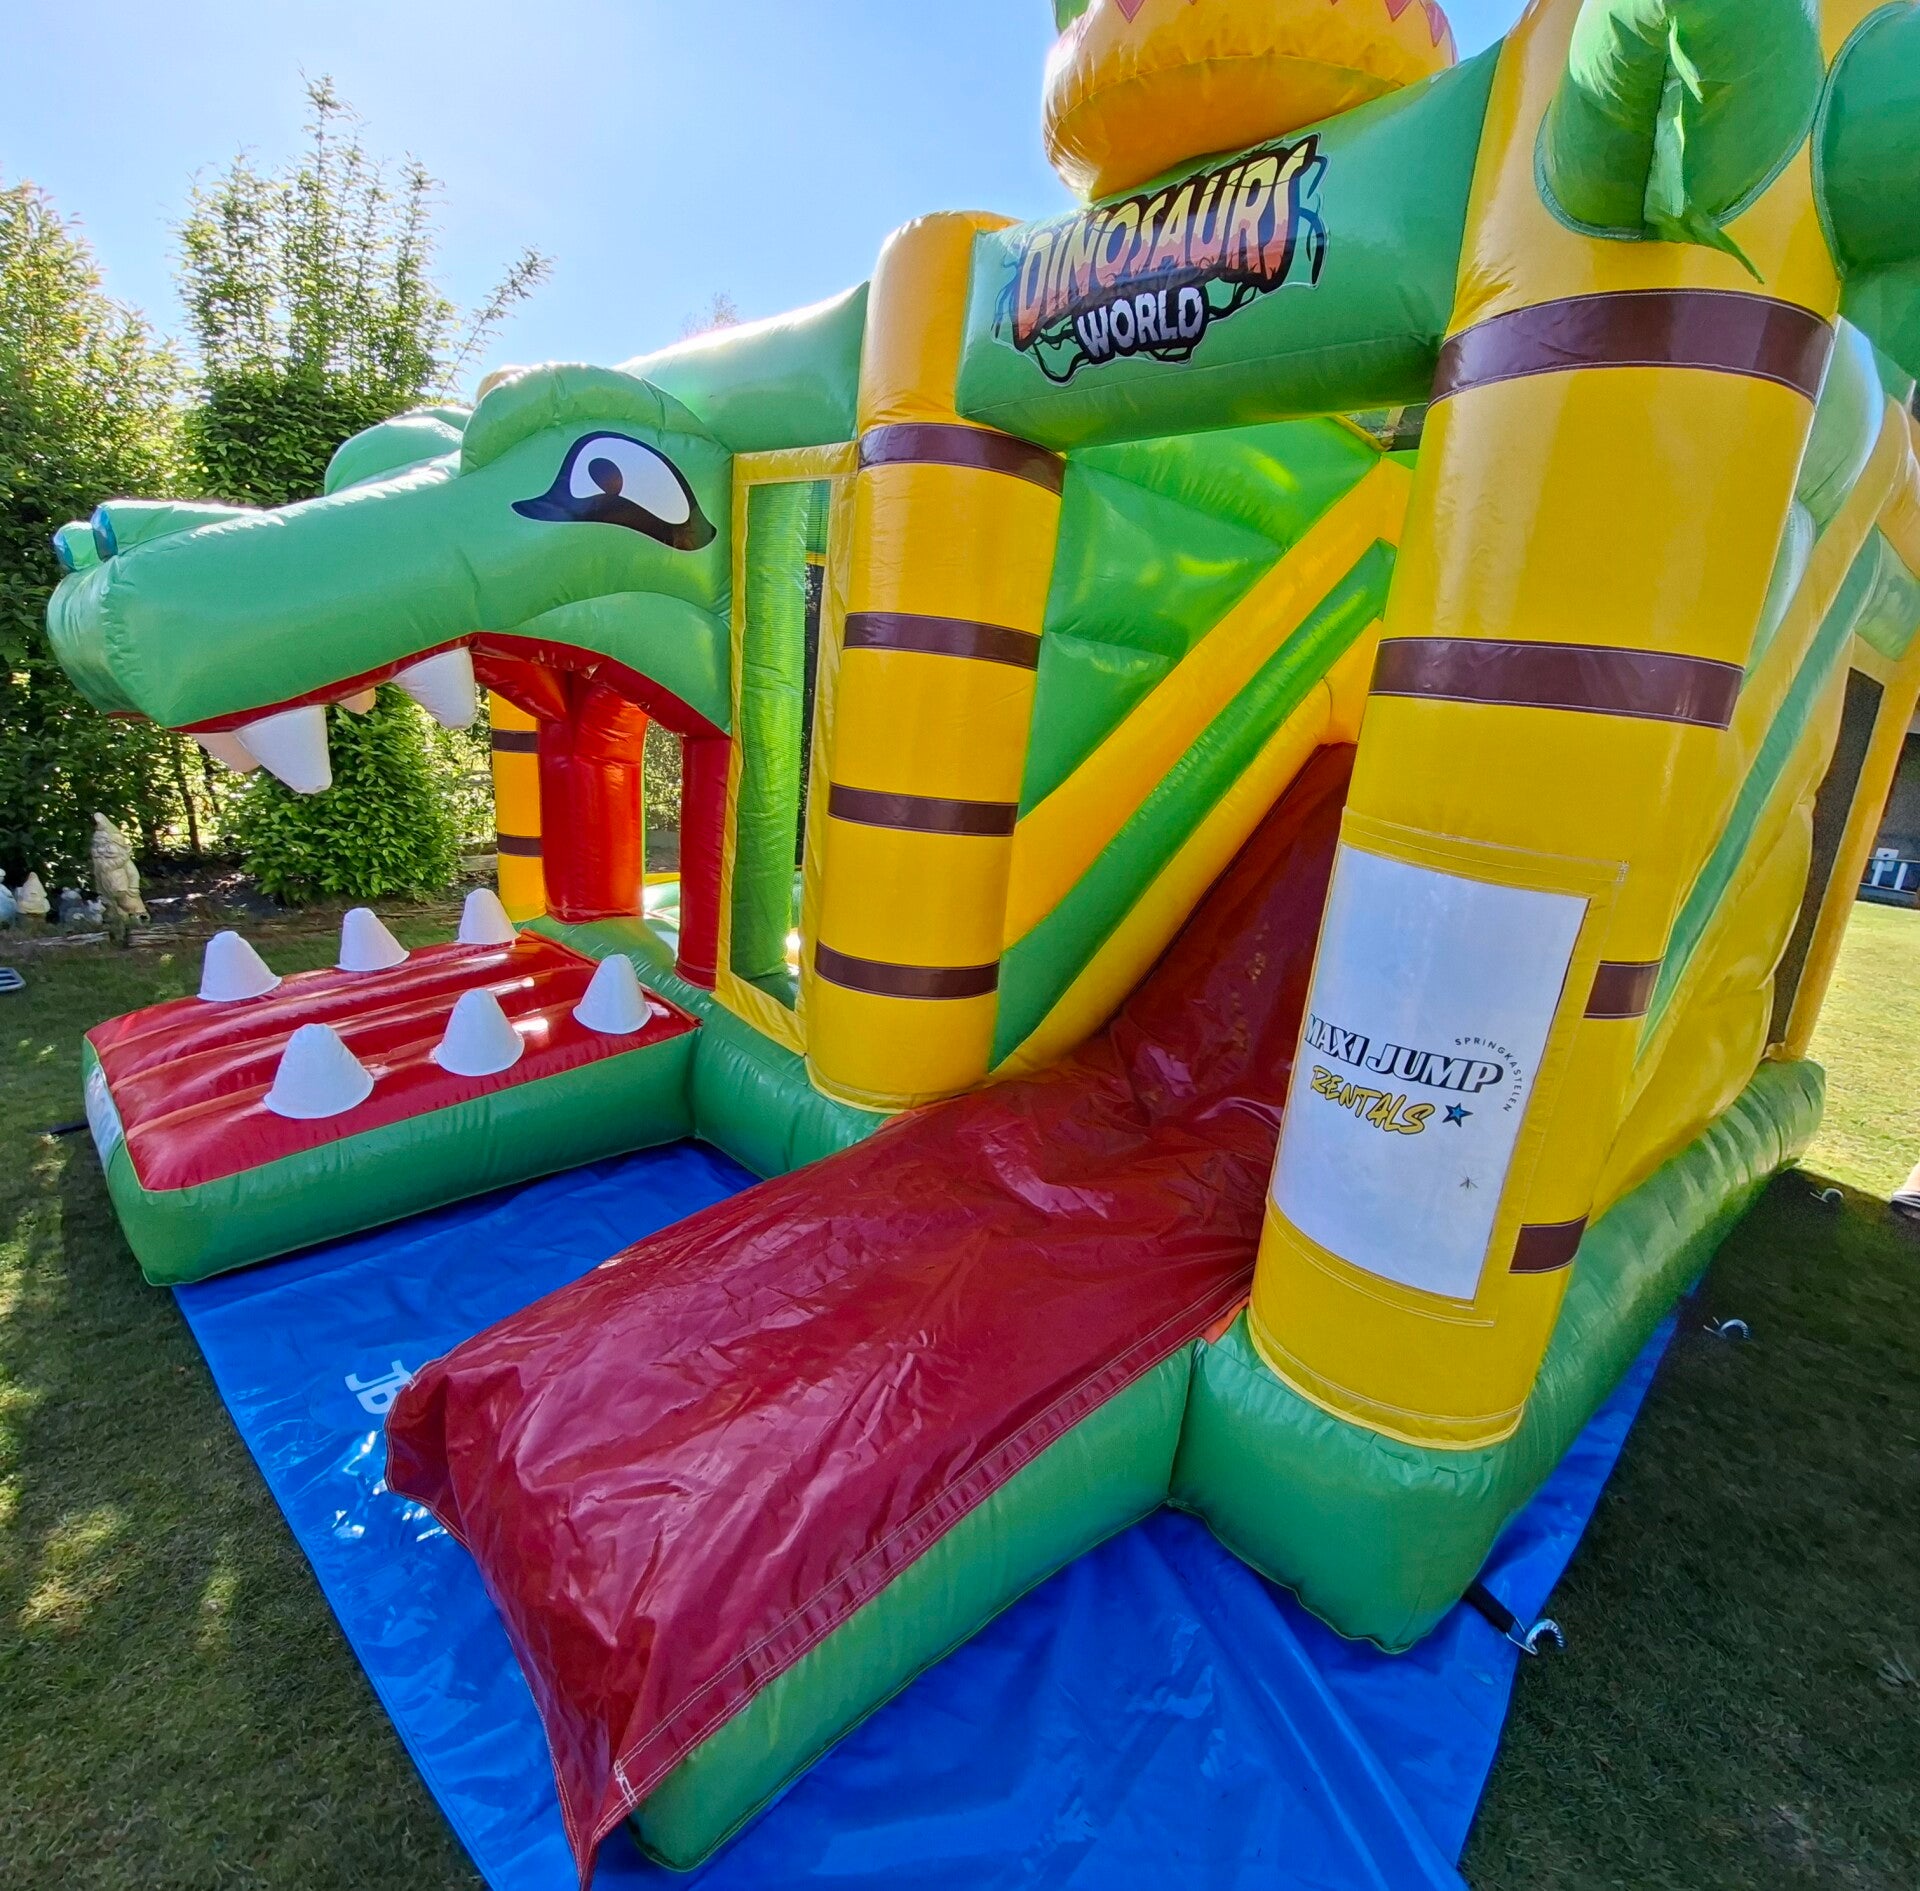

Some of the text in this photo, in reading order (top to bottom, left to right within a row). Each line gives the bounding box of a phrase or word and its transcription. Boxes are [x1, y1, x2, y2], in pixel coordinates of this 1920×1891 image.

[1016, 139, 1310, 342] DINOSAURS
[1077, 286, 1204, 355] WORLD
[1304, 1013, 1504, 1093] MAXI JUMP
[1454, 1036, 1523, 1112] SPRINGKASTELEN
[1310, 1064, 1436, 1136] RENTALS
